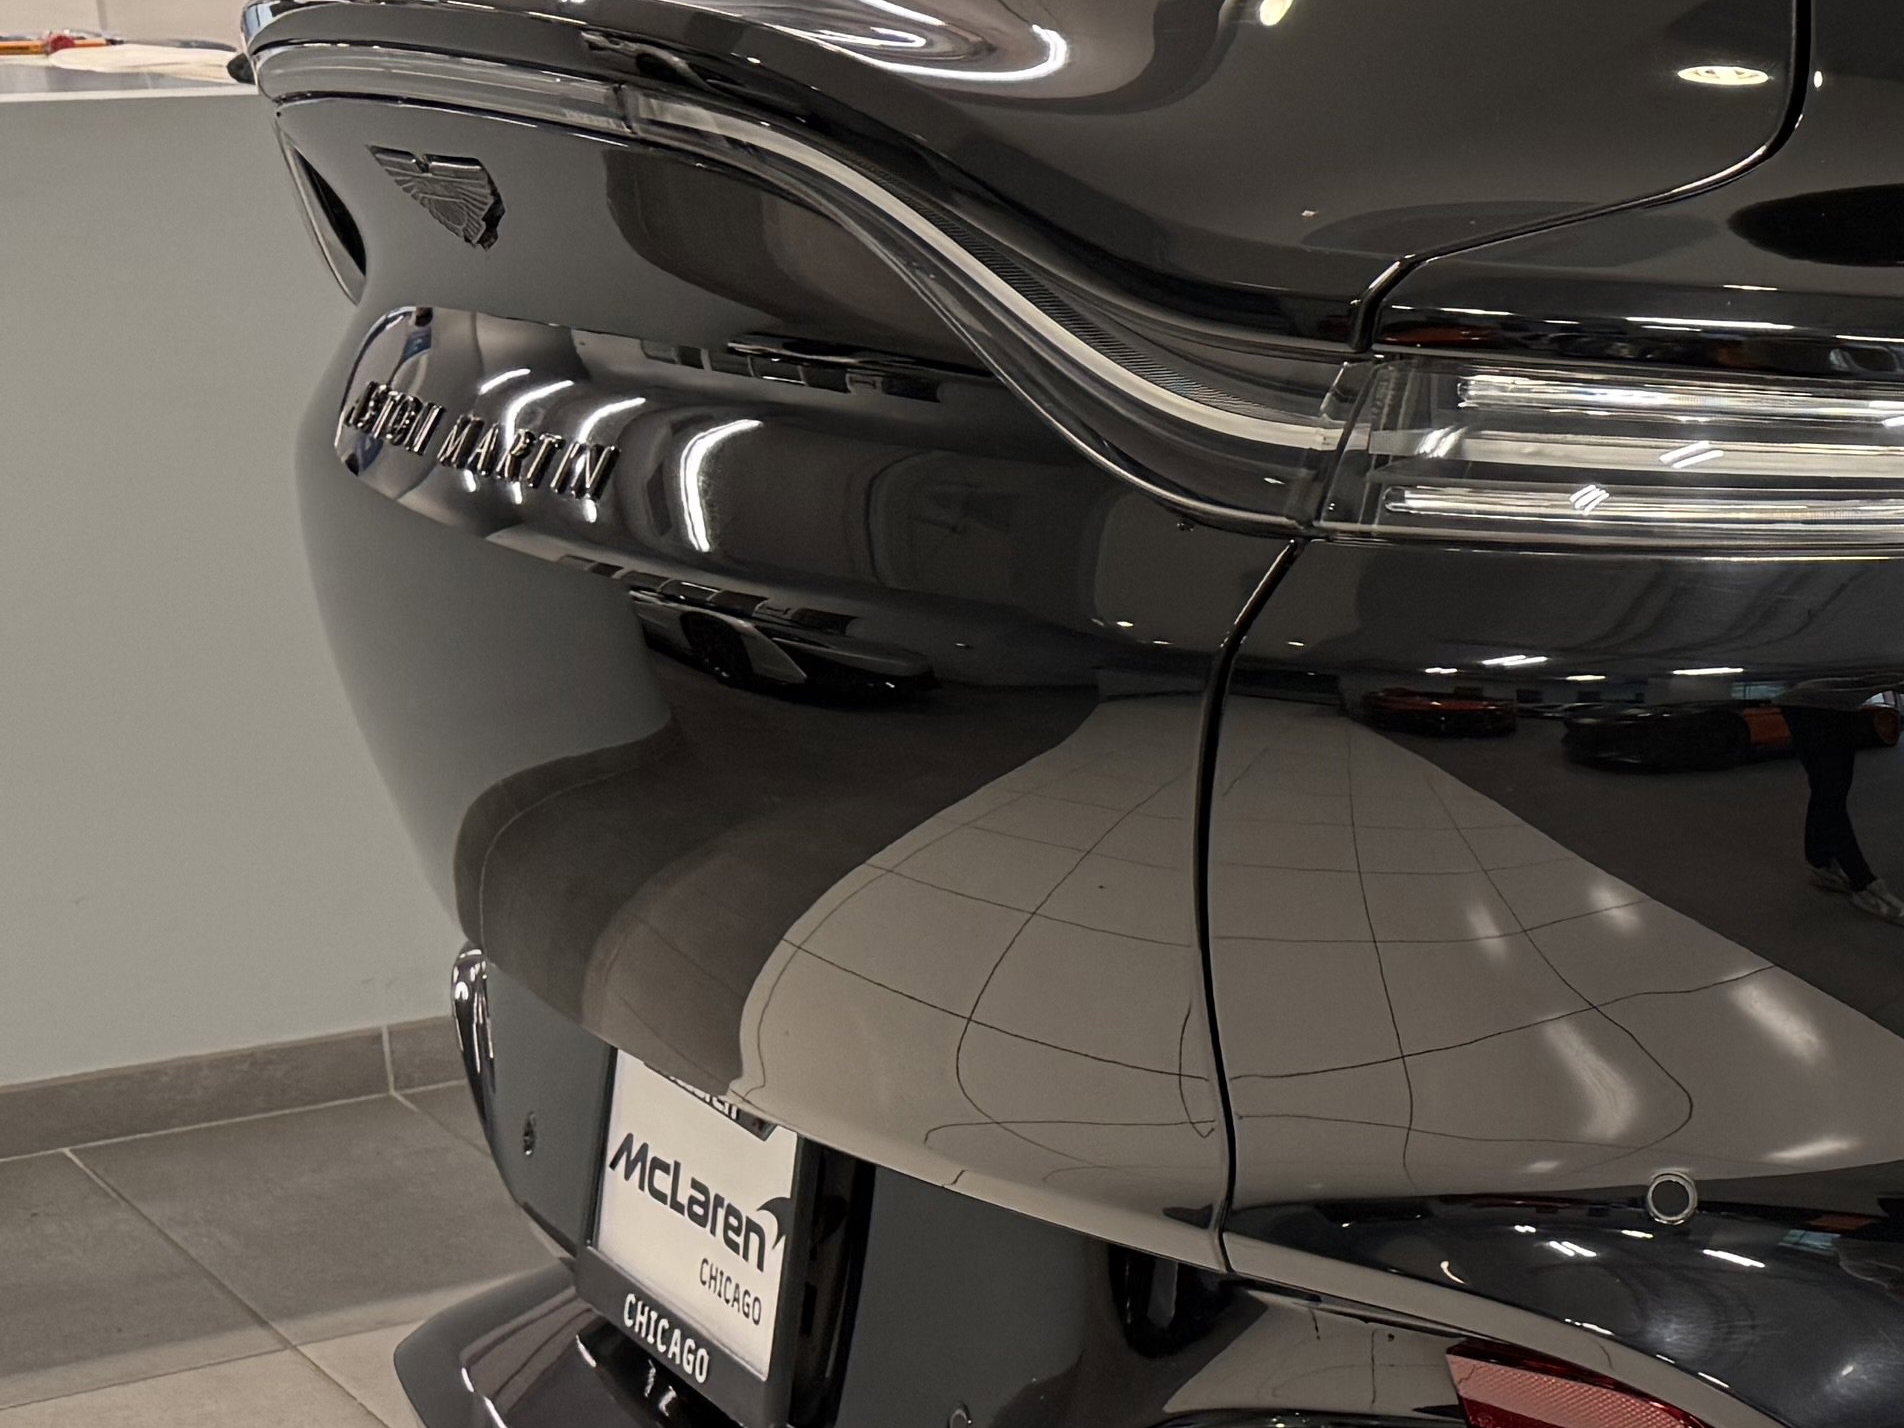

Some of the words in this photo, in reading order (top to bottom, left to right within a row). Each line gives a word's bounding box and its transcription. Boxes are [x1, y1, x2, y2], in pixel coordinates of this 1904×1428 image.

[436, 413, 621, 500] MARTIN
[608, 1132, 767, 1273] McLaren
[699, 1257, 762, 1326] CHICAGO
[623, 1292, 710, 1384] CHICAGO
